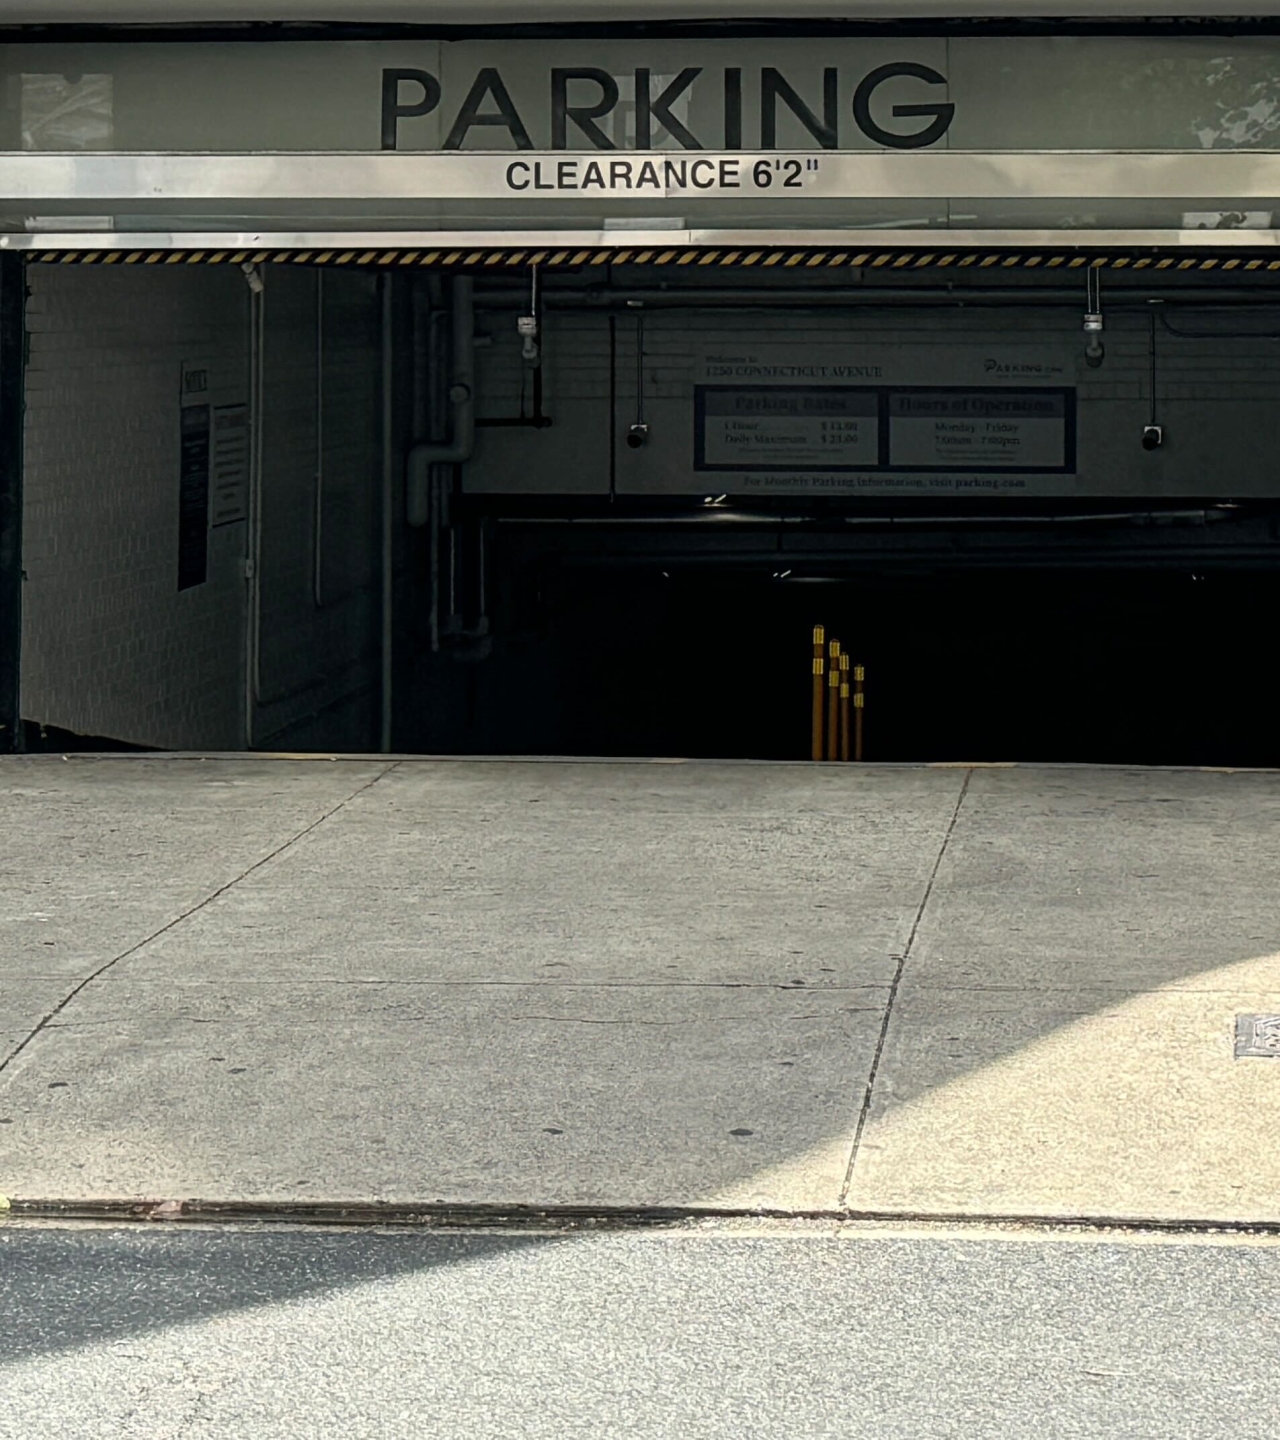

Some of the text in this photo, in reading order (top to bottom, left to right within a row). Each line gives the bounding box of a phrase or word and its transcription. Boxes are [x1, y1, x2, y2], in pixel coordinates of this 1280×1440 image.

[380, 62, 955, 150] PARKING
[505, 158, 819, 190] CLEARANCE 6'2"
[735, 365, 828, 378] CONNECTICUT
[830, 365, 883, 378] AVENUE
